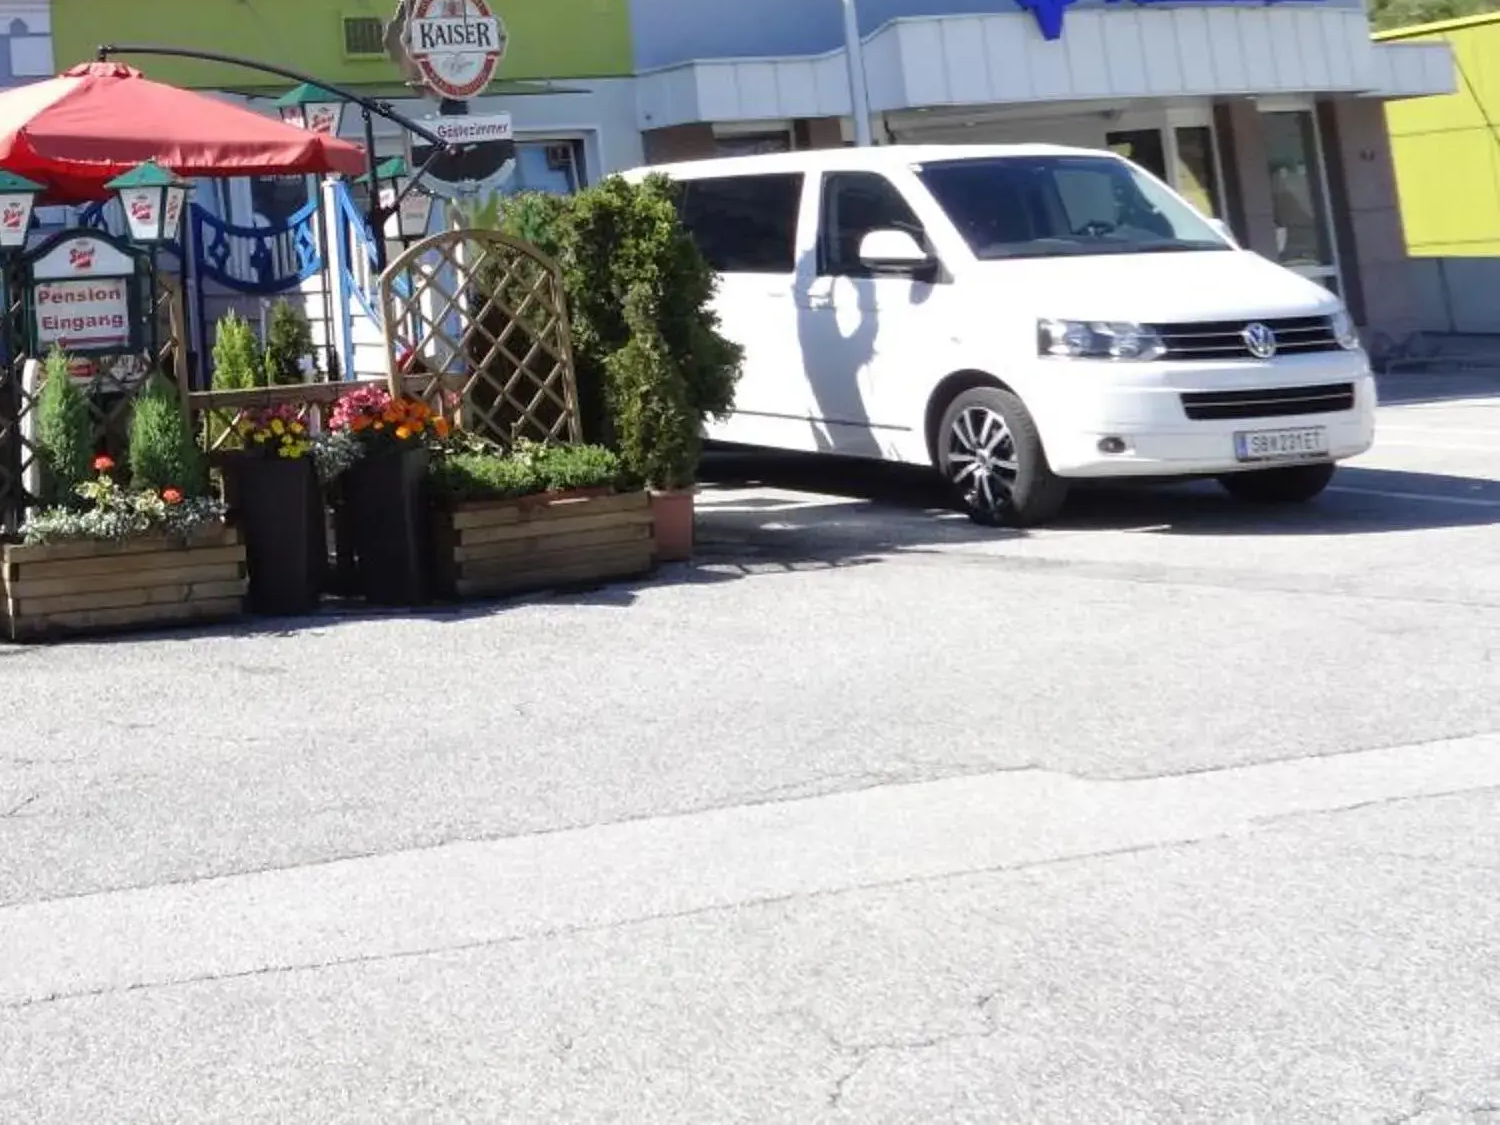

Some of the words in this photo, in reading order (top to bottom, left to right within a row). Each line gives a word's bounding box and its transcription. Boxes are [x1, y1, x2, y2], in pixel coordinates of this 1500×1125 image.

[420, 22, 491, 49] KAISER
[37, 286, 121, 305] Pension
[41, 313, 124, 332] Eingang
